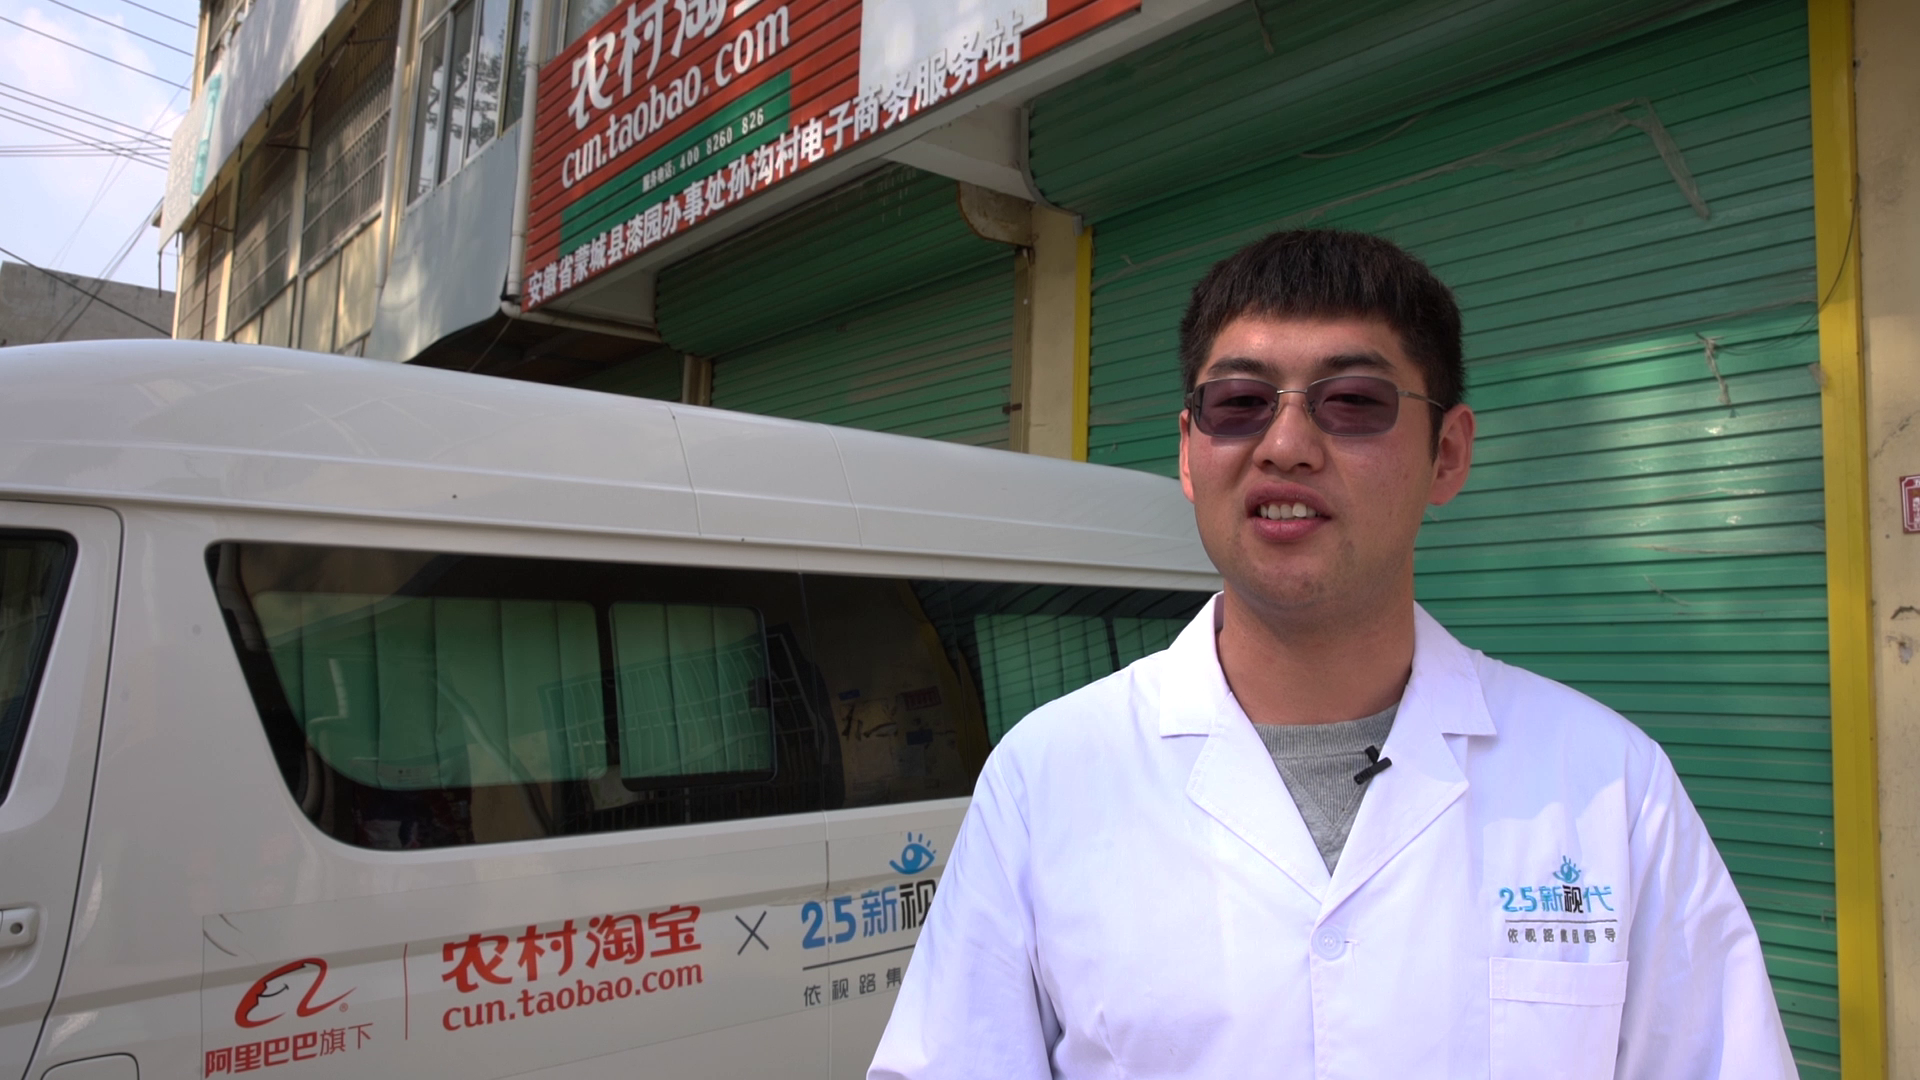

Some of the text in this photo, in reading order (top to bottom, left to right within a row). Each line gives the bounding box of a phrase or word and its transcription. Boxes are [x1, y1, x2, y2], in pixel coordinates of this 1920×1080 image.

[568, 0, 761, 130] 农村淘
[528, 10, 1024, 307] 安徽省蒙城县漆园办事处孙沟村电子商务服务站
[680, 146, 700, 169] 400
[706, 127, 733, 155] 8260
[741, 108, 764, 135] 826
[441, 905, 702, 993] 农村淘宝
[442, 963, 703, 1031] cun.taobao.com
[205, 1023, 373, 1079] 阿里巴巴旗下
